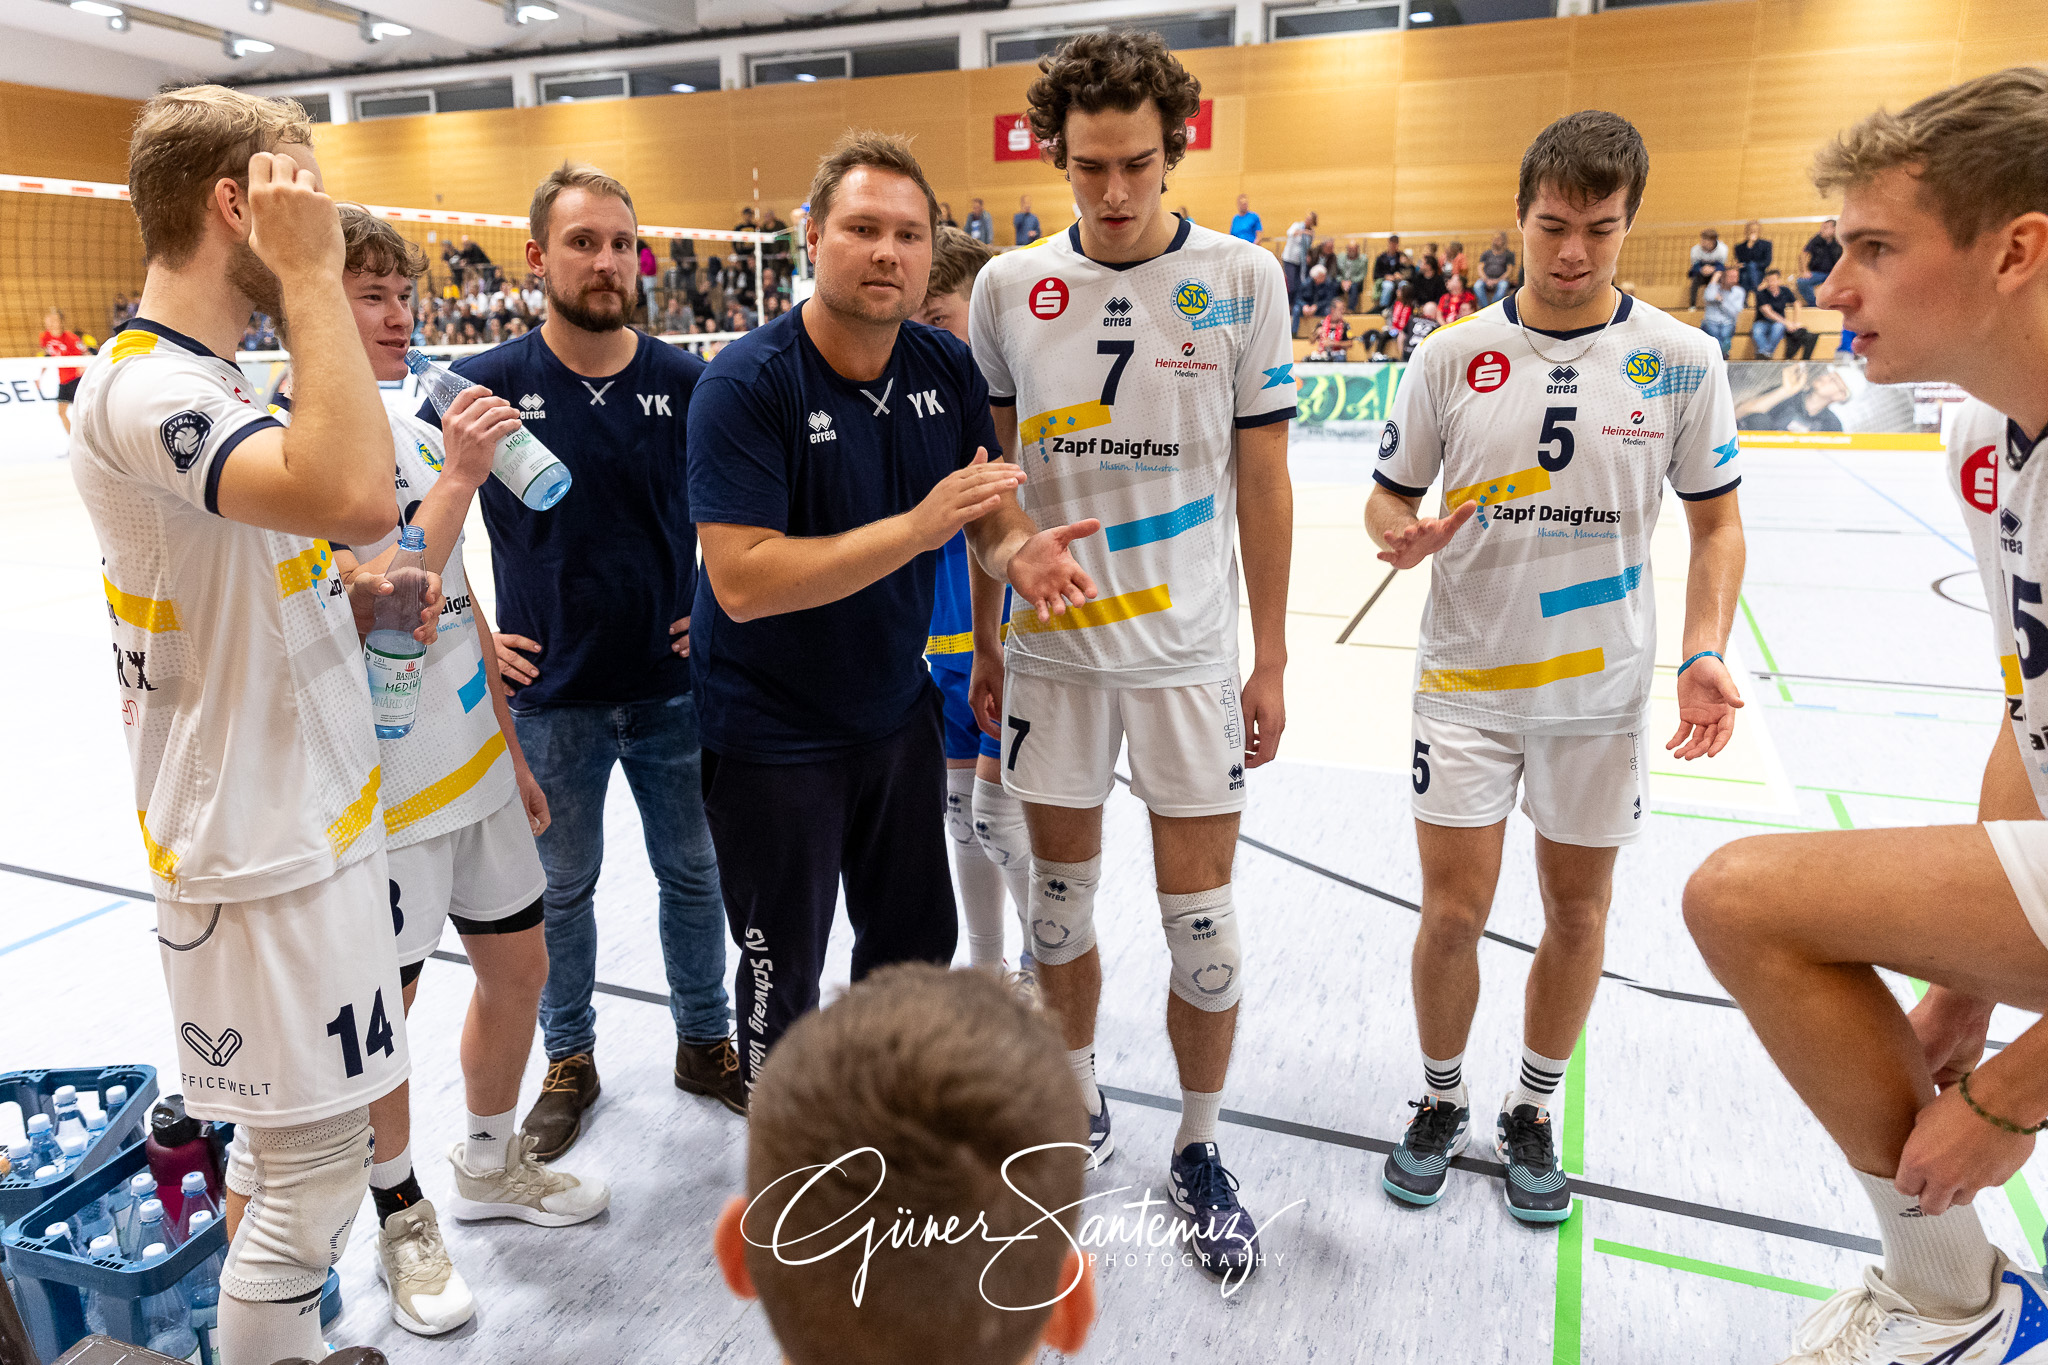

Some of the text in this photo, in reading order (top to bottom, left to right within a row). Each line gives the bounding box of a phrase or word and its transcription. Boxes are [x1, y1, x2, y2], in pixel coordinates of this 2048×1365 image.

[1097, 340, 1135, 406] 7
[1155, 358, 1218, 371] Heinzelmann
[1174, 370, 1198, 378] Medien
[636, 393, 672, 417] YK
[906, 389, 945, 419] YK
[1538, 407, 1577, 472] 5
[1601, 425, 1665, 440] Heinzelmann
[1622, 437, 1646, 446] Medien
[1053, 437, 1179, 459] Zapf Daigfuss
[1493, 505, 1621, 526] Zapf Daigfuss
[2012, 574, 2048, 680] 5
[1007, 714, 1031, 772] 7
[1412, 738, 1431, 795] 5
[745, 927, 769, 951] SV
[748, 958, 774, 1035] Schwaig
[326, 984, 394, 1079] 14
[182, 1073, 271, 1096] FFICEWELT
